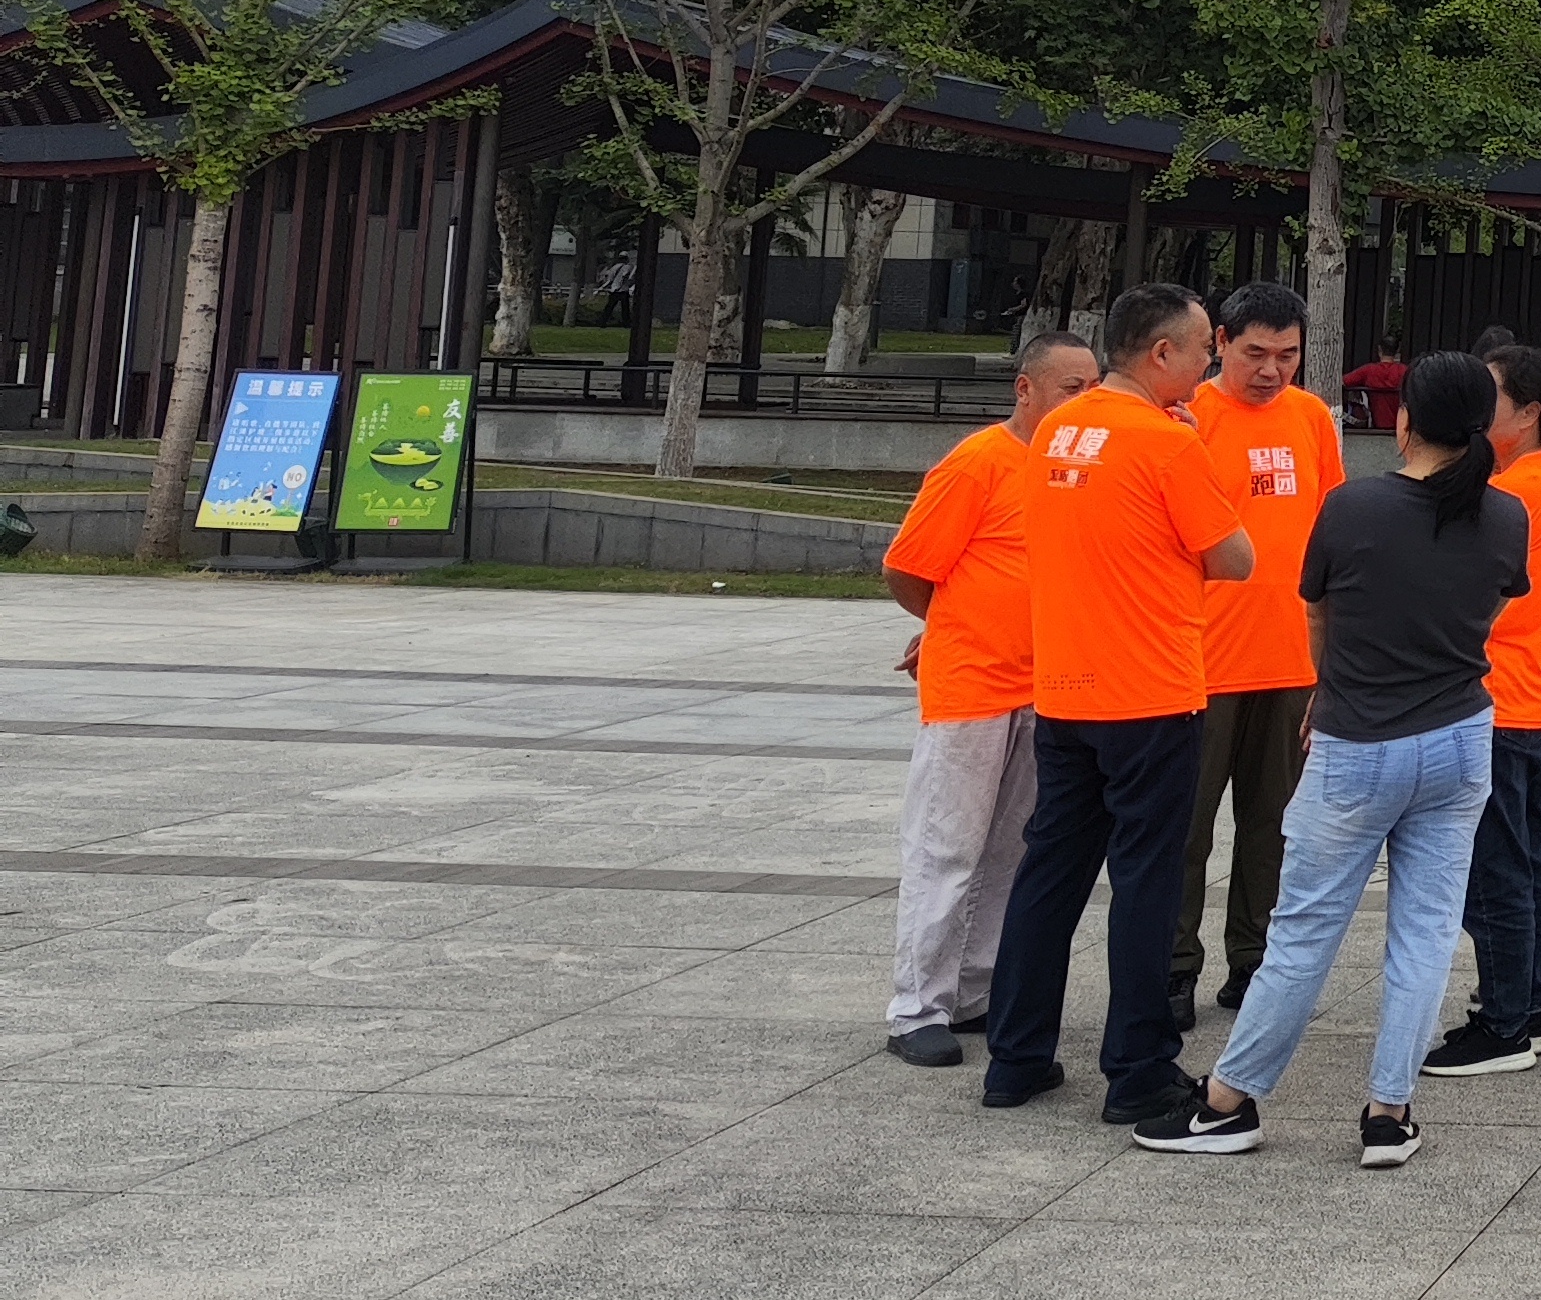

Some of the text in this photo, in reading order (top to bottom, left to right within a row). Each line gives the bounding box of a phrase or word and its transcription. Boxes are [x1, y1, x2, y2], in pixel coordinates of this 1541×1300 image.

[439, 398, 462, 443] 友善
[1047, 425, 1110, 458] 视障
[1248, 446, 1295, 473] 黑暗
[286, 472, 302, 482] NO
[1250, 472, 1297, 497] 跑团
